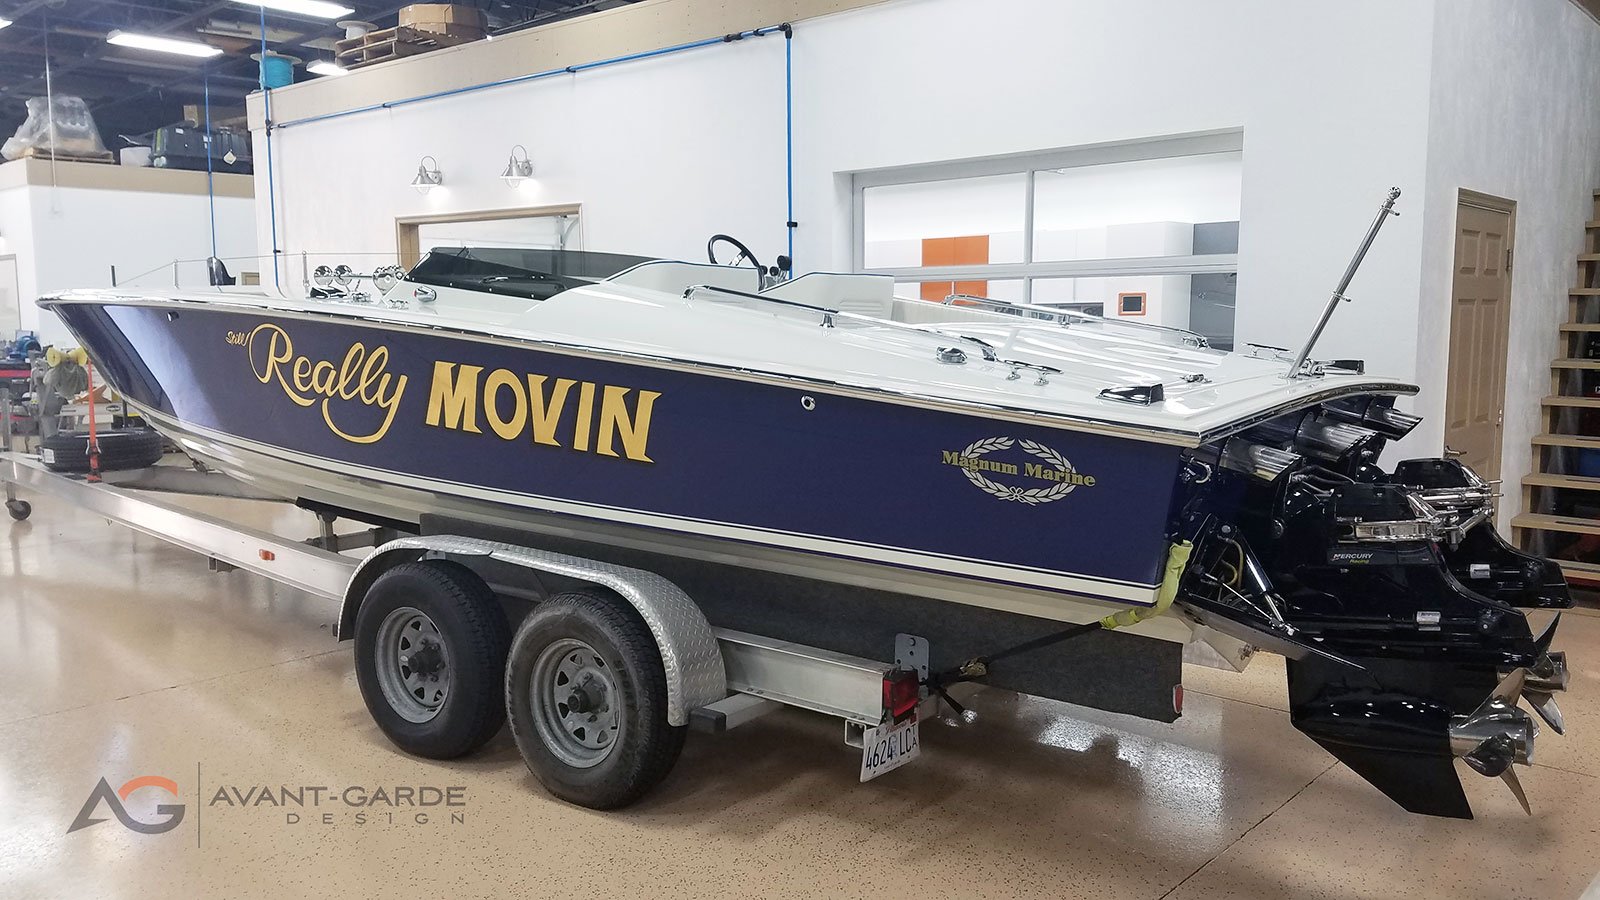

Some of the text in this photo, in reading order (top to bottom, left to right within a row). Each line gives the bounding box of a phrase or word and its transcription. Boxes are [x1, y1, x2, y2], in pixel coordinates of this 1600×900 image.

[248, 323, 409, 444] Really
[425, 360, 662, 464] MOVIN
[941, 450, 1096, 487] Magnum Marine
[866, 736, 893, 770] 4624
